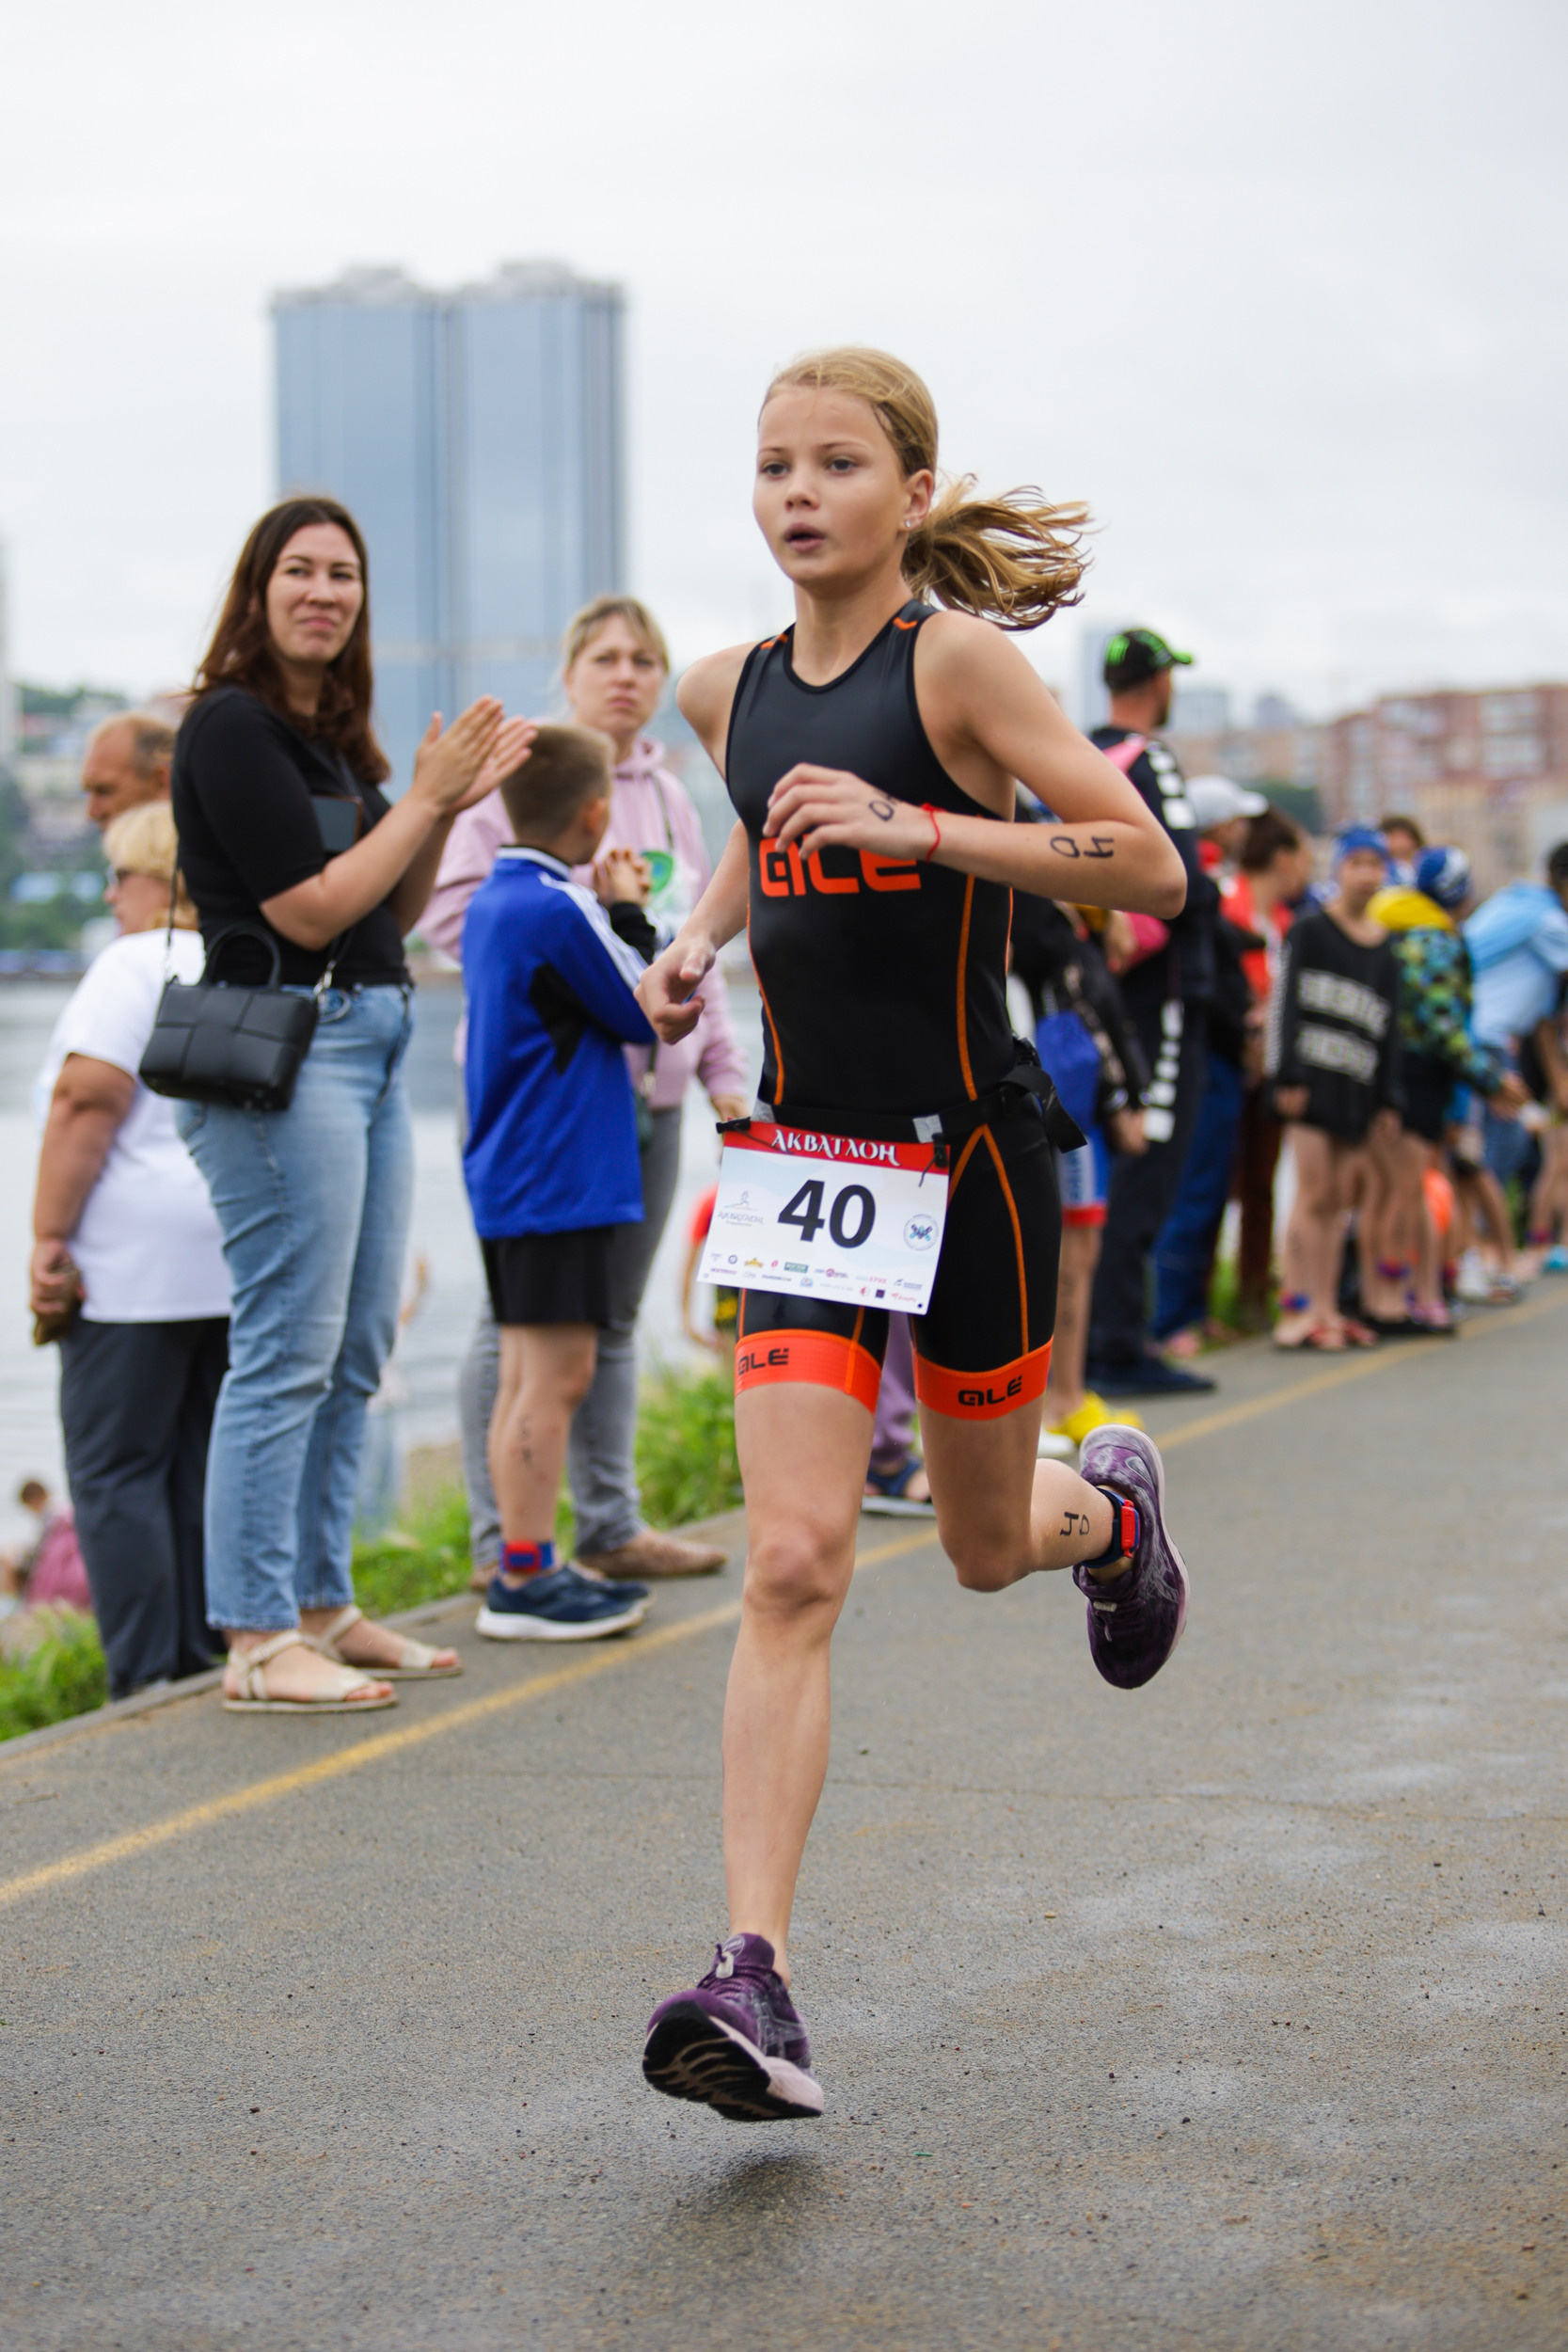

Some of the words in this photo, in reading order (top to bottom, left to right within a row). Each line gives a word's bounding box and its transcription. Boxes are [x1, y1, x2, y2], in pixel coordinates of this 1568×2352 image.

[1050, 834, 1115, 859] 40
[771, 1129, 901, 1167] АКВАТЛОН
[777, 1179, 876, 1249] 40
